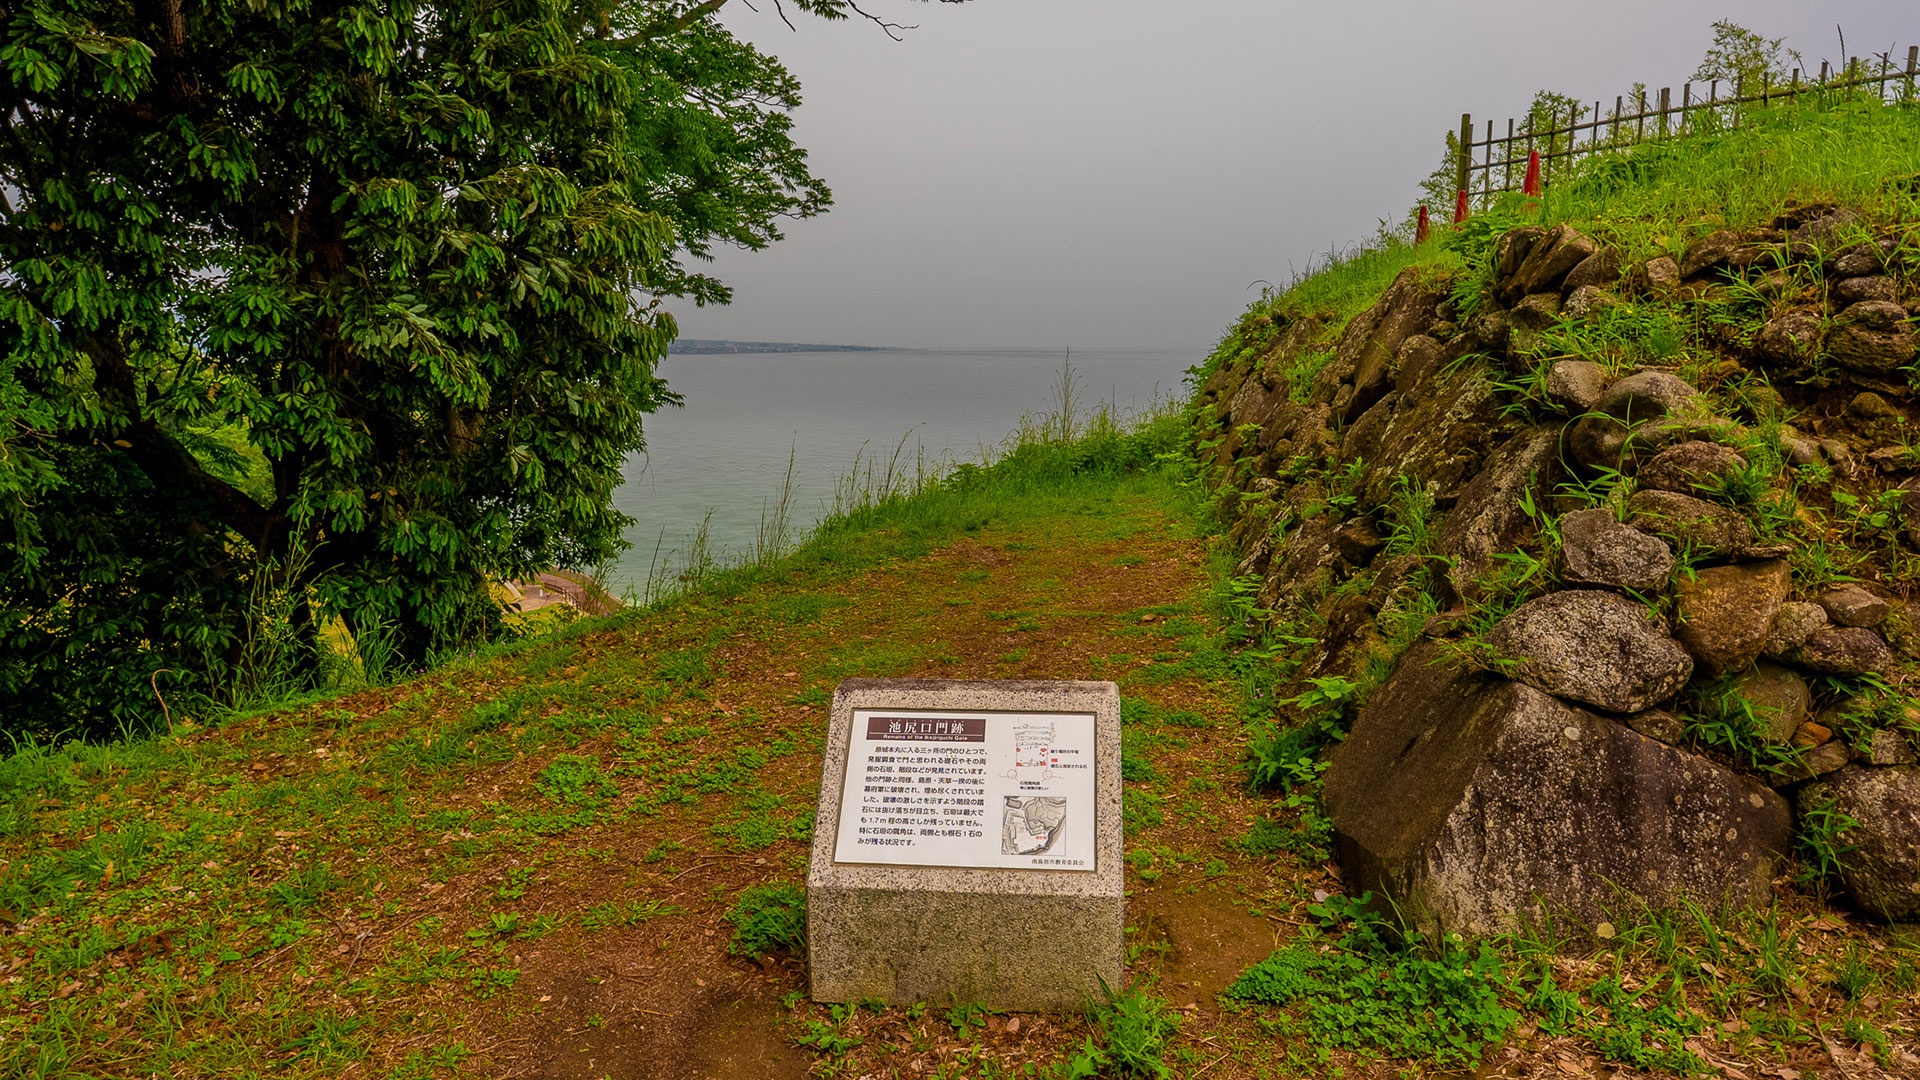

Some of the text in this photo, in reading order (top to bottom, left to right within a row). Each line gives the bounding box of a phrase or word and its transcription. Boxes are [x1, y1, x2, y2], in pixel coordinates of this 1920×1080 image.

[889, 721, 965, 734] 池尻口門跡
[857, 838, 916, 847] みが残る状況です。
